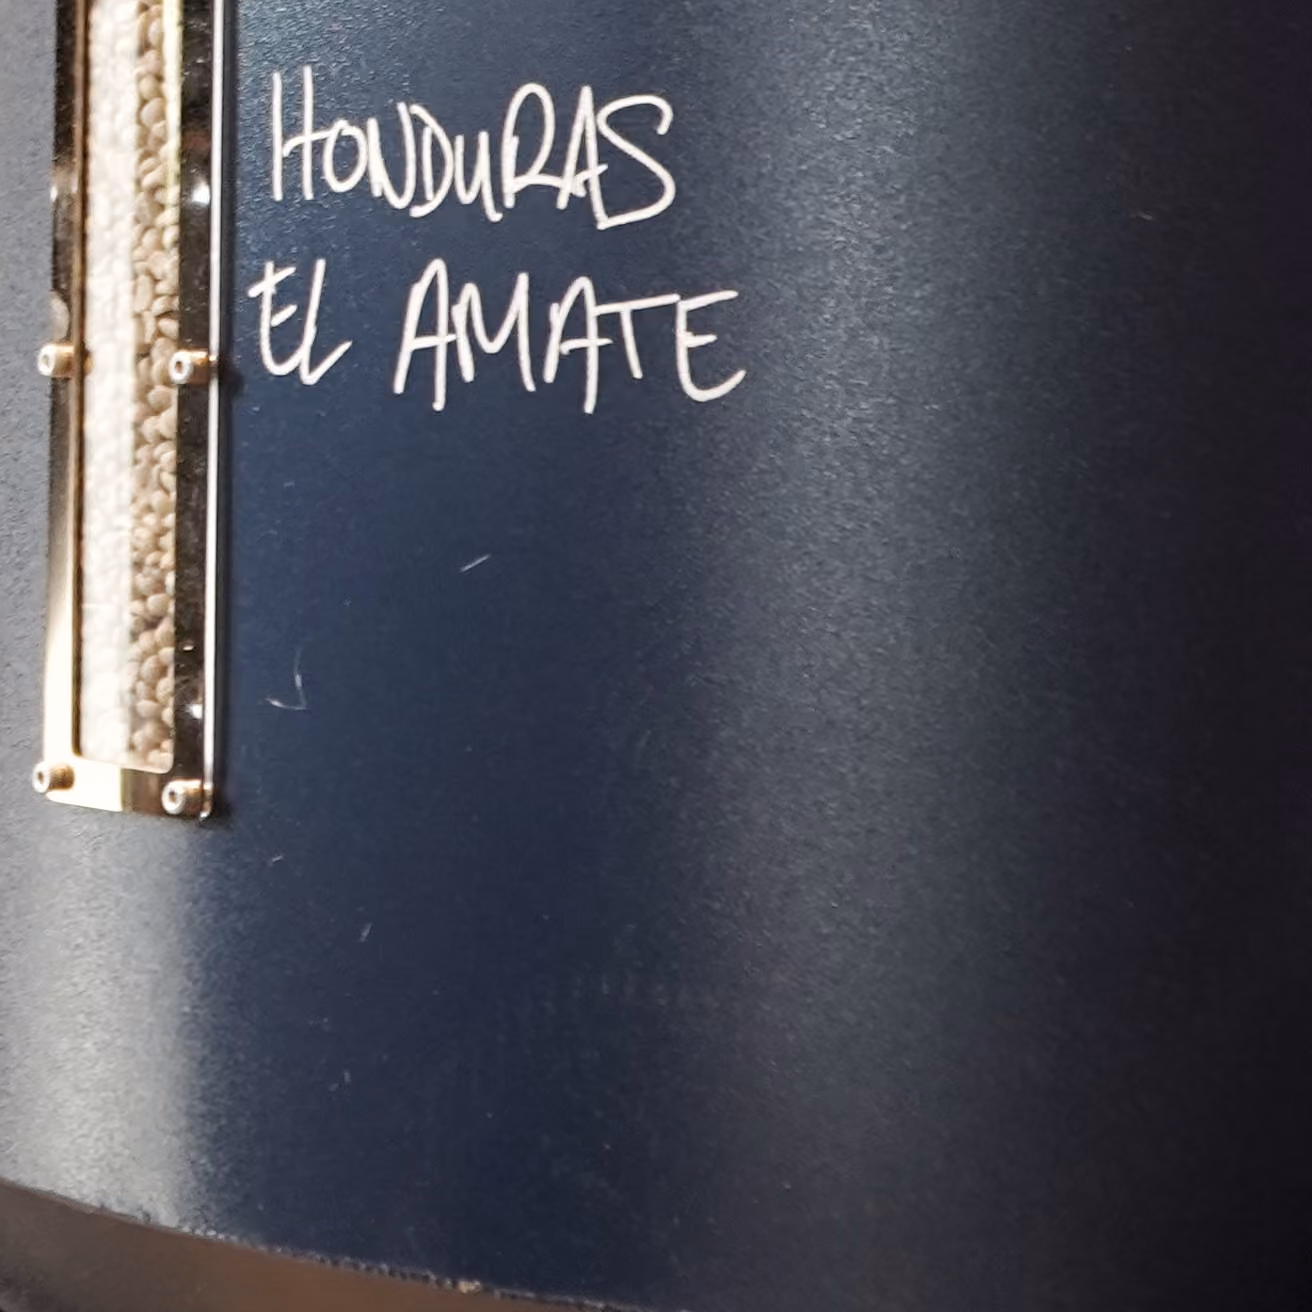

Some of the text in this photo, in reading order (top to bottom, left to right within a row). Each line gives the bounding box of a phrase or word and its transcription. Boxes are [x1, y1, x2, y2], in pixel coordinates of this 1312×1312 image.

[270, 64, 676, 230] HONDURAS
[247, 257, 747, 415] EL AMATE
